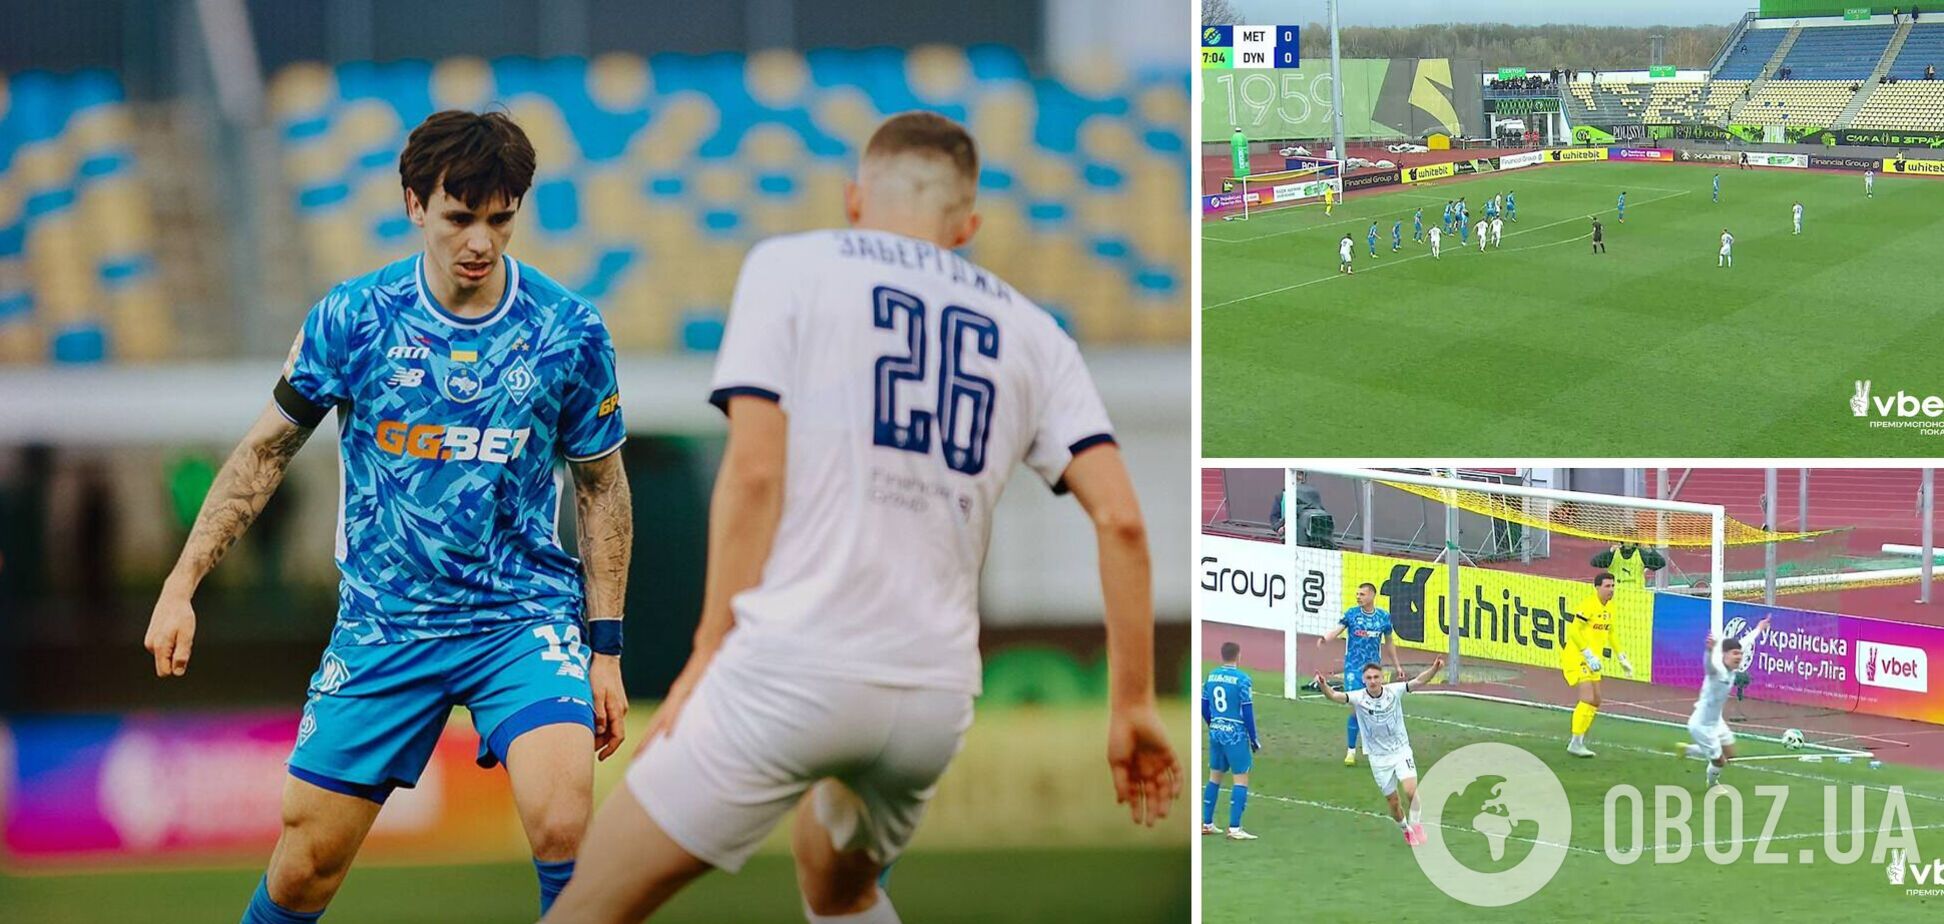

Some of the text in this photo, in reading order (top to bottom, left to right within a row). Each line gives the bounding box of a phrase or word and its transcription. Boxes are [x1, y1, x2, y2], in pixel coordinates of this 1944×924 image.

[1216, 73, 1345, 125] 1959
[1563, 150, 1600, 159] whitebit
[1811, 157, 1870, 168] Financial Group
[1344, 174, 1392, 187] Financial Group
[1418, 166, 1448, 178] whitebit
[872, 285, 999, 477] 26
[1201, 556, 1286, 608] Group
[1438, 584, 1577, 650] whiteb
[1759, 627, 1848, 657] Українська
[1881, 657, 1918, 679] vbet
[1213, 685, 1228, 713] 8
